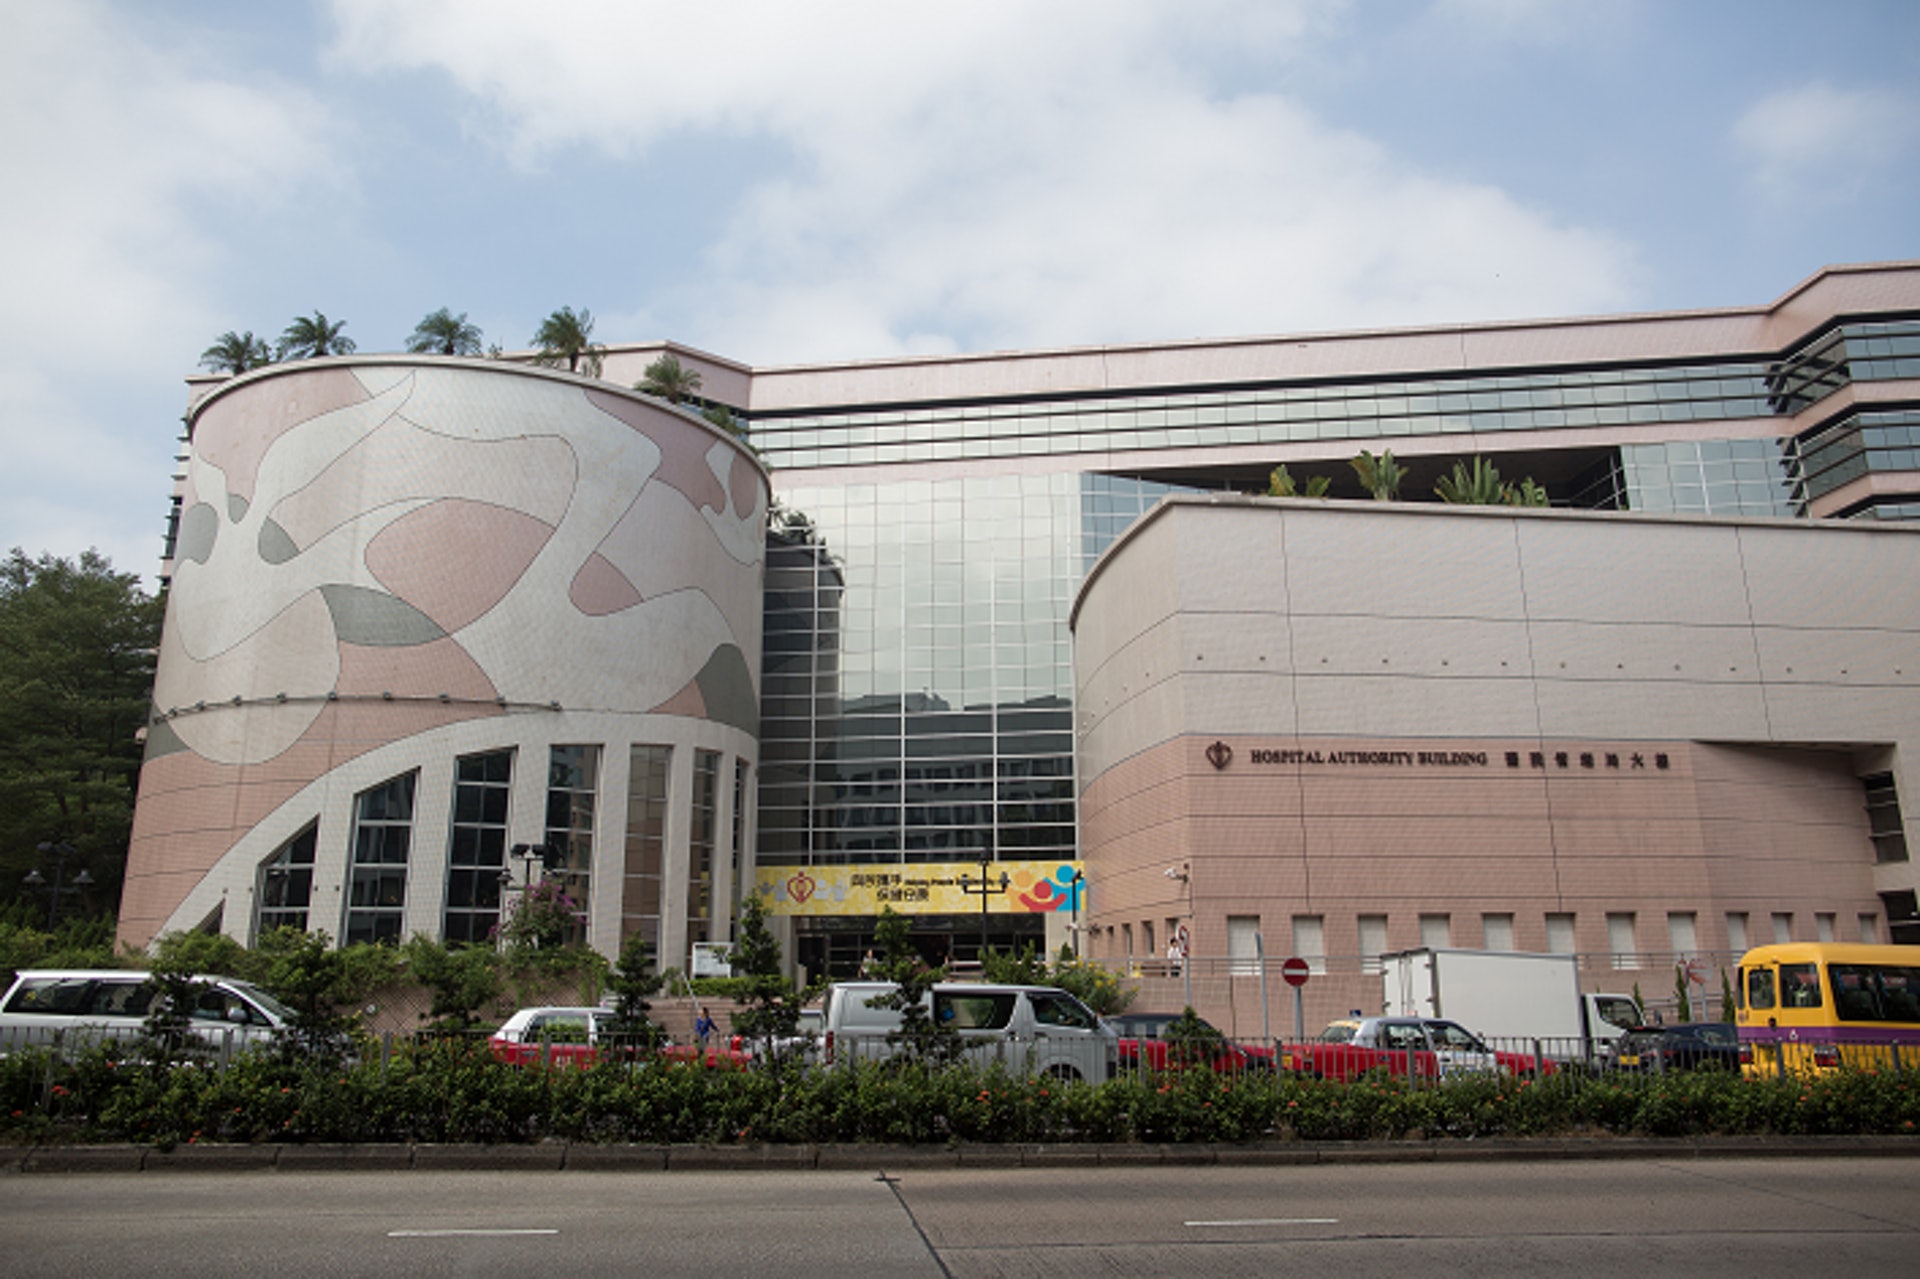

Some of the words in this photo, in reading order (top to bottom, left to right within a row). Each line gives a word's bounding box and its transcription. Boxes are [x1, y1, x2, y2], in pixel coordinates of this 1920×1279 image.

[1250, 749, 1324, 765] HOSPITAL
[1327, 751, 1414, 766] AUTHORITY
[1417, 752, 1488, 767] BUILDING
